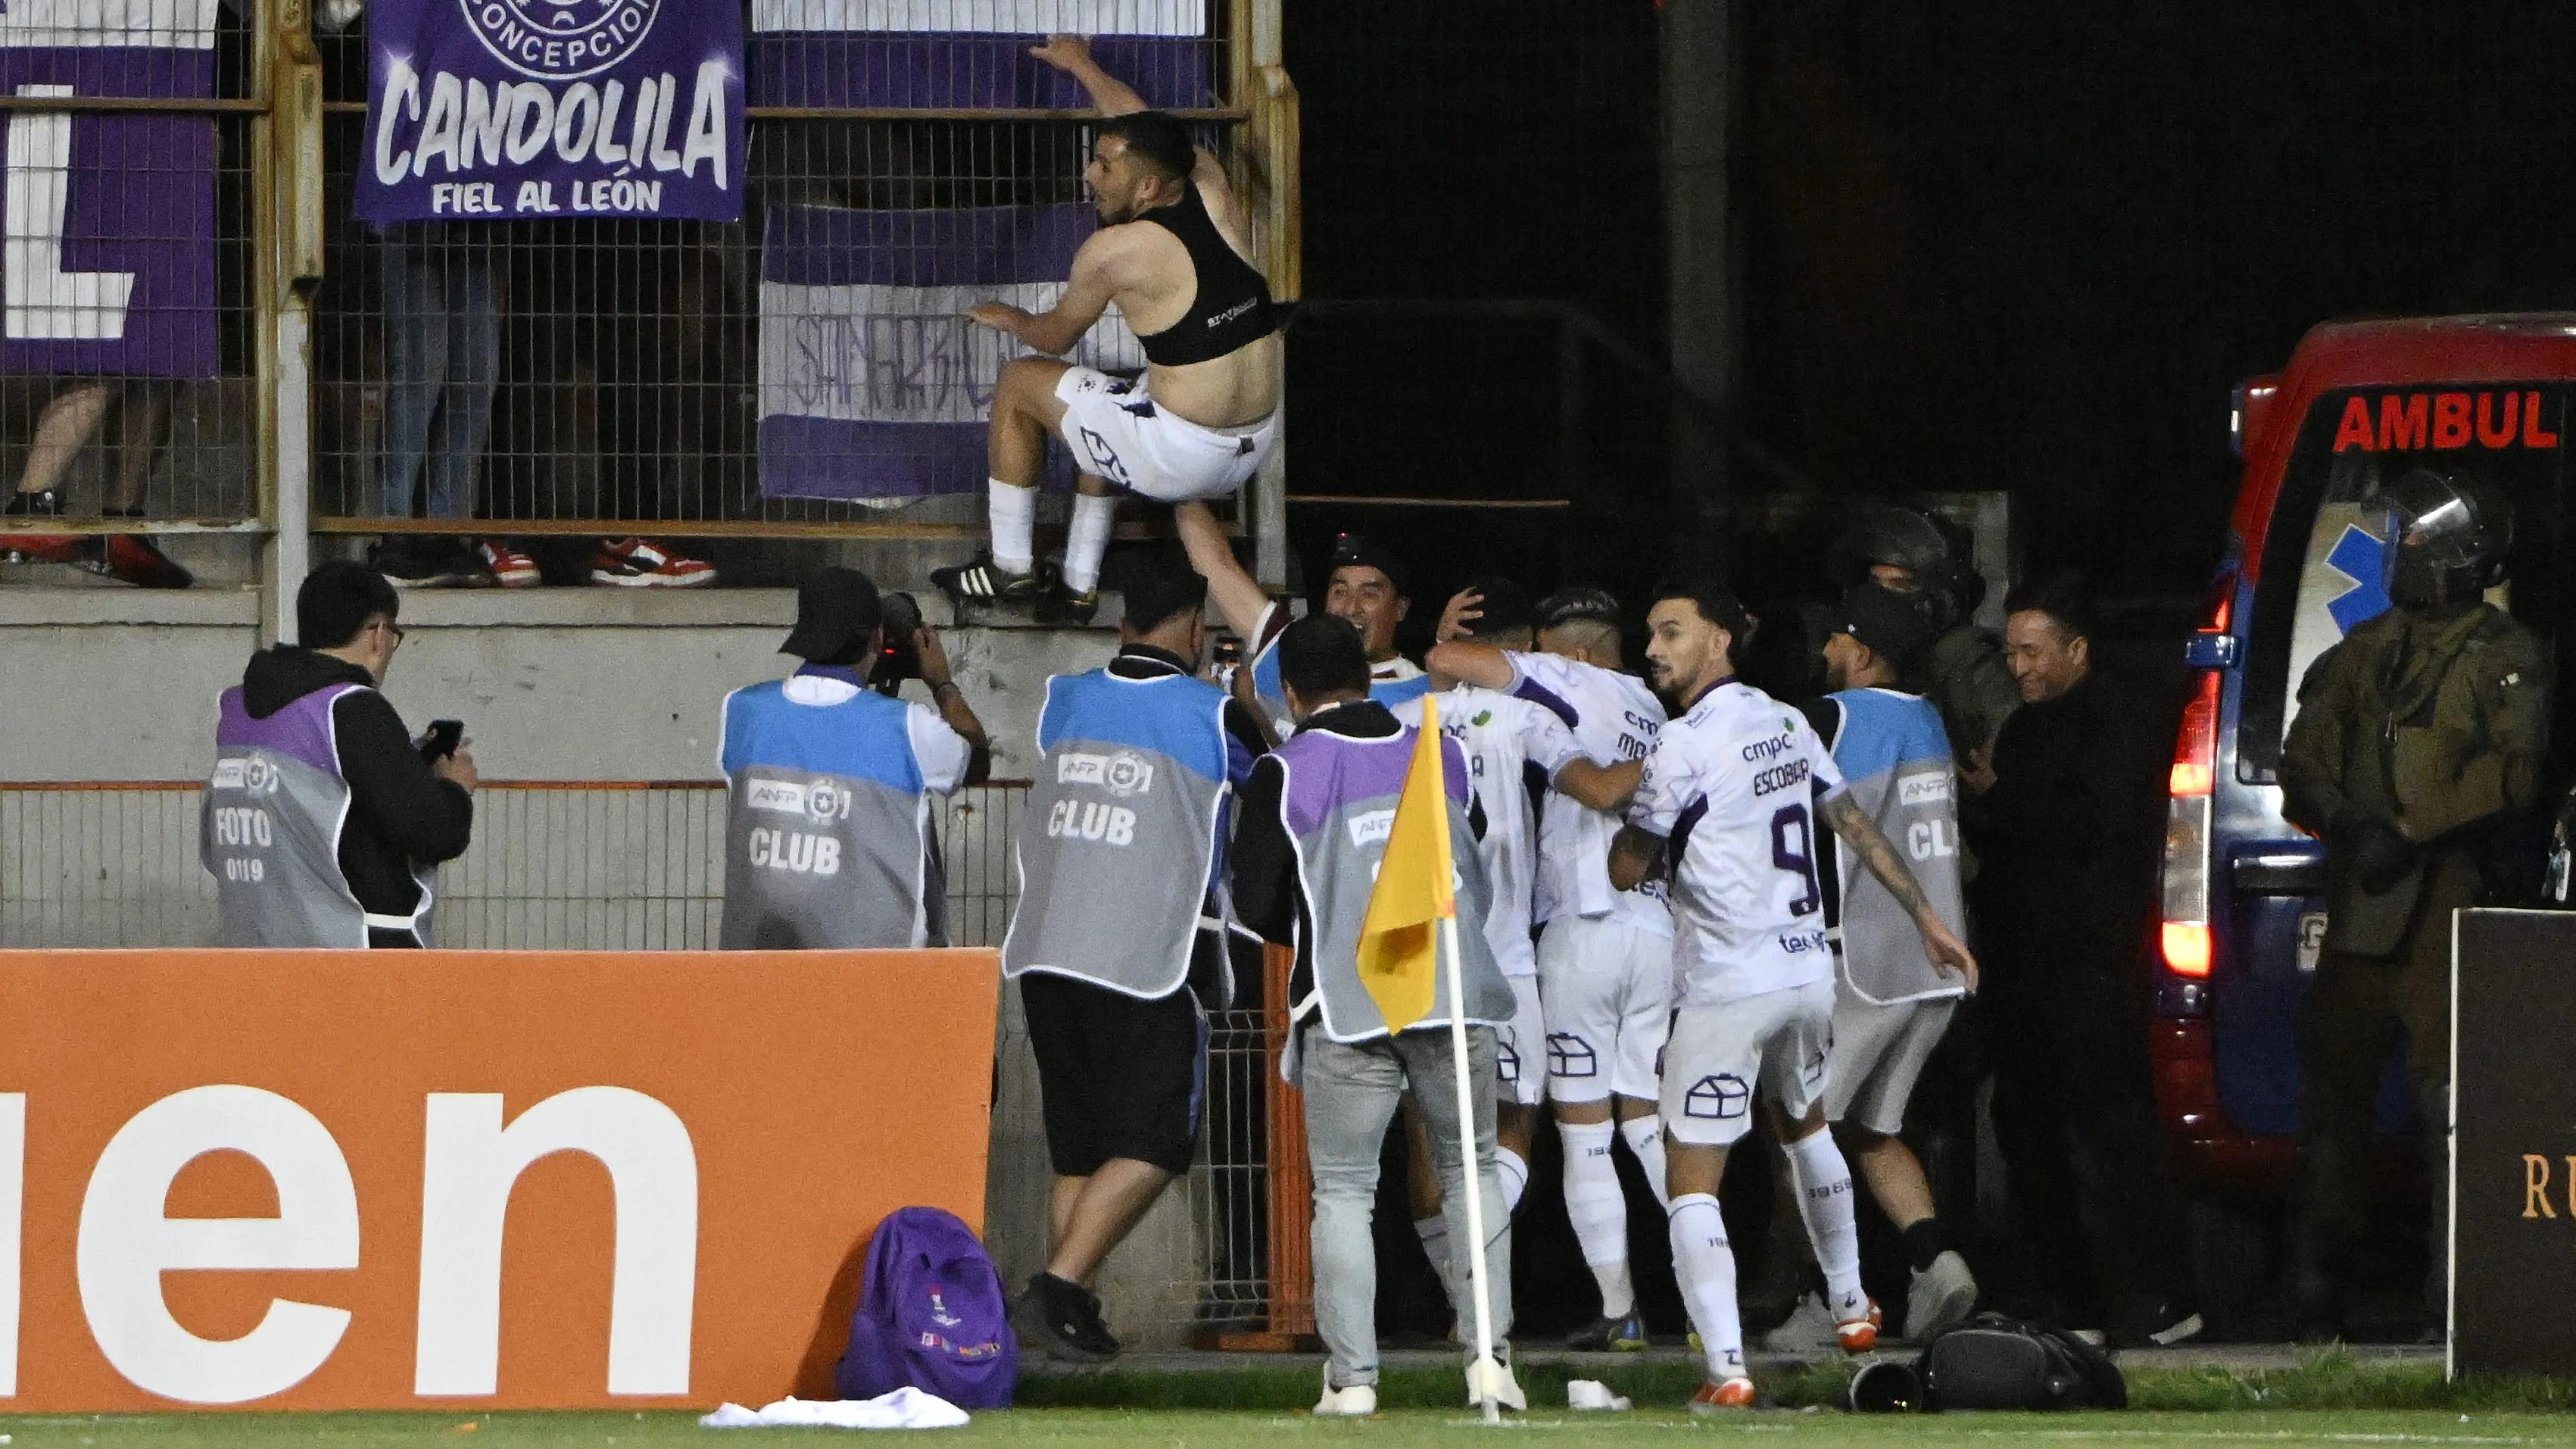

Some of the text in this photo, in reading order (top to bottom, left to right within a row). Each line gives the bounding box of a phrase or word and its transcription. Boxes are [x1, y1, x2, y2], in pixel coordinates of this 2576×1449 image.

[471, 0, 650, 67] ONCEPCIO
[376, 61, 728, 191] CANDOLILA
[432, 166, 662, 214] FIEL AL LEÓN
[2332, 391, 2558, 453] AMBUL
[1742, 732, 1793, 762] cmpc
[1754, 758, 1809, 796] ESCOBAR
[216, 807, 273, 847] FOTO
[1048, 799, 1136, 846] CLUB
[1907, 818, 1958, 862] CL
[226, 857, 263, 882] 0119
[748, 827, 841, 875] CLUB
[1770, 802, 1821, 917] 9
